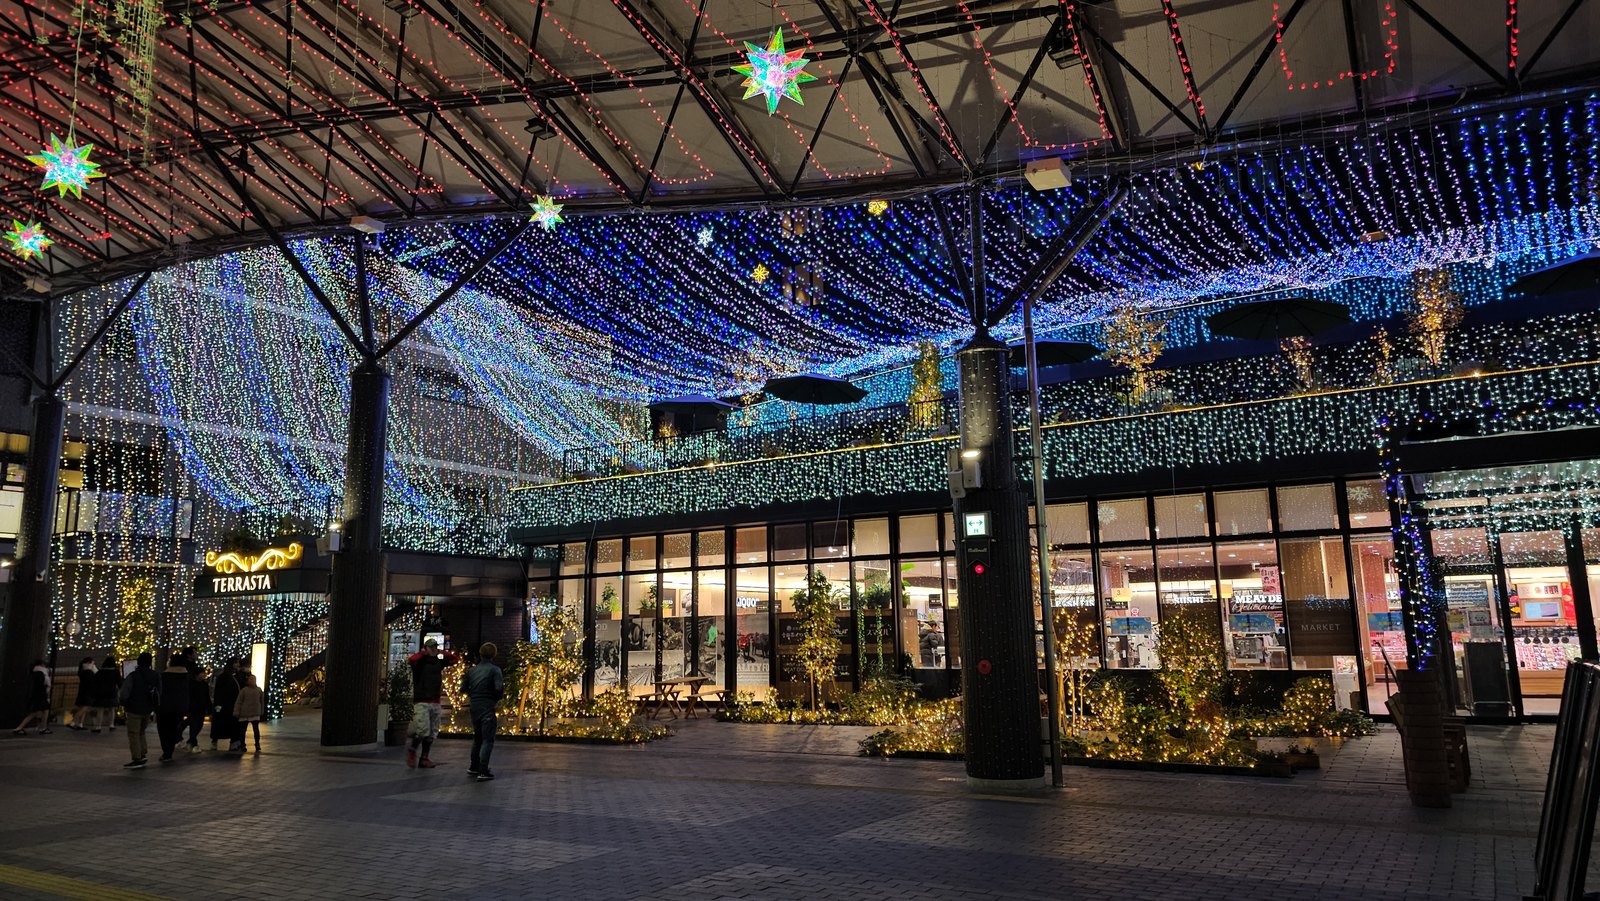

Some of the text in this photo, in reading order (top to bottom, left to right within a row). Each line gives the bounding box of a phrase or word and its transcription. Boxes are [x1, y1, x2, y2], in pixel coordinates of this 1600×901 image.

[212, 574, 271, 593] TERRASTA
[1173, 596, 1204, 604] SUSHI
[1235, 594, 1267, 604] MEAT
[1301, 623, 1341, 632] MARKET
